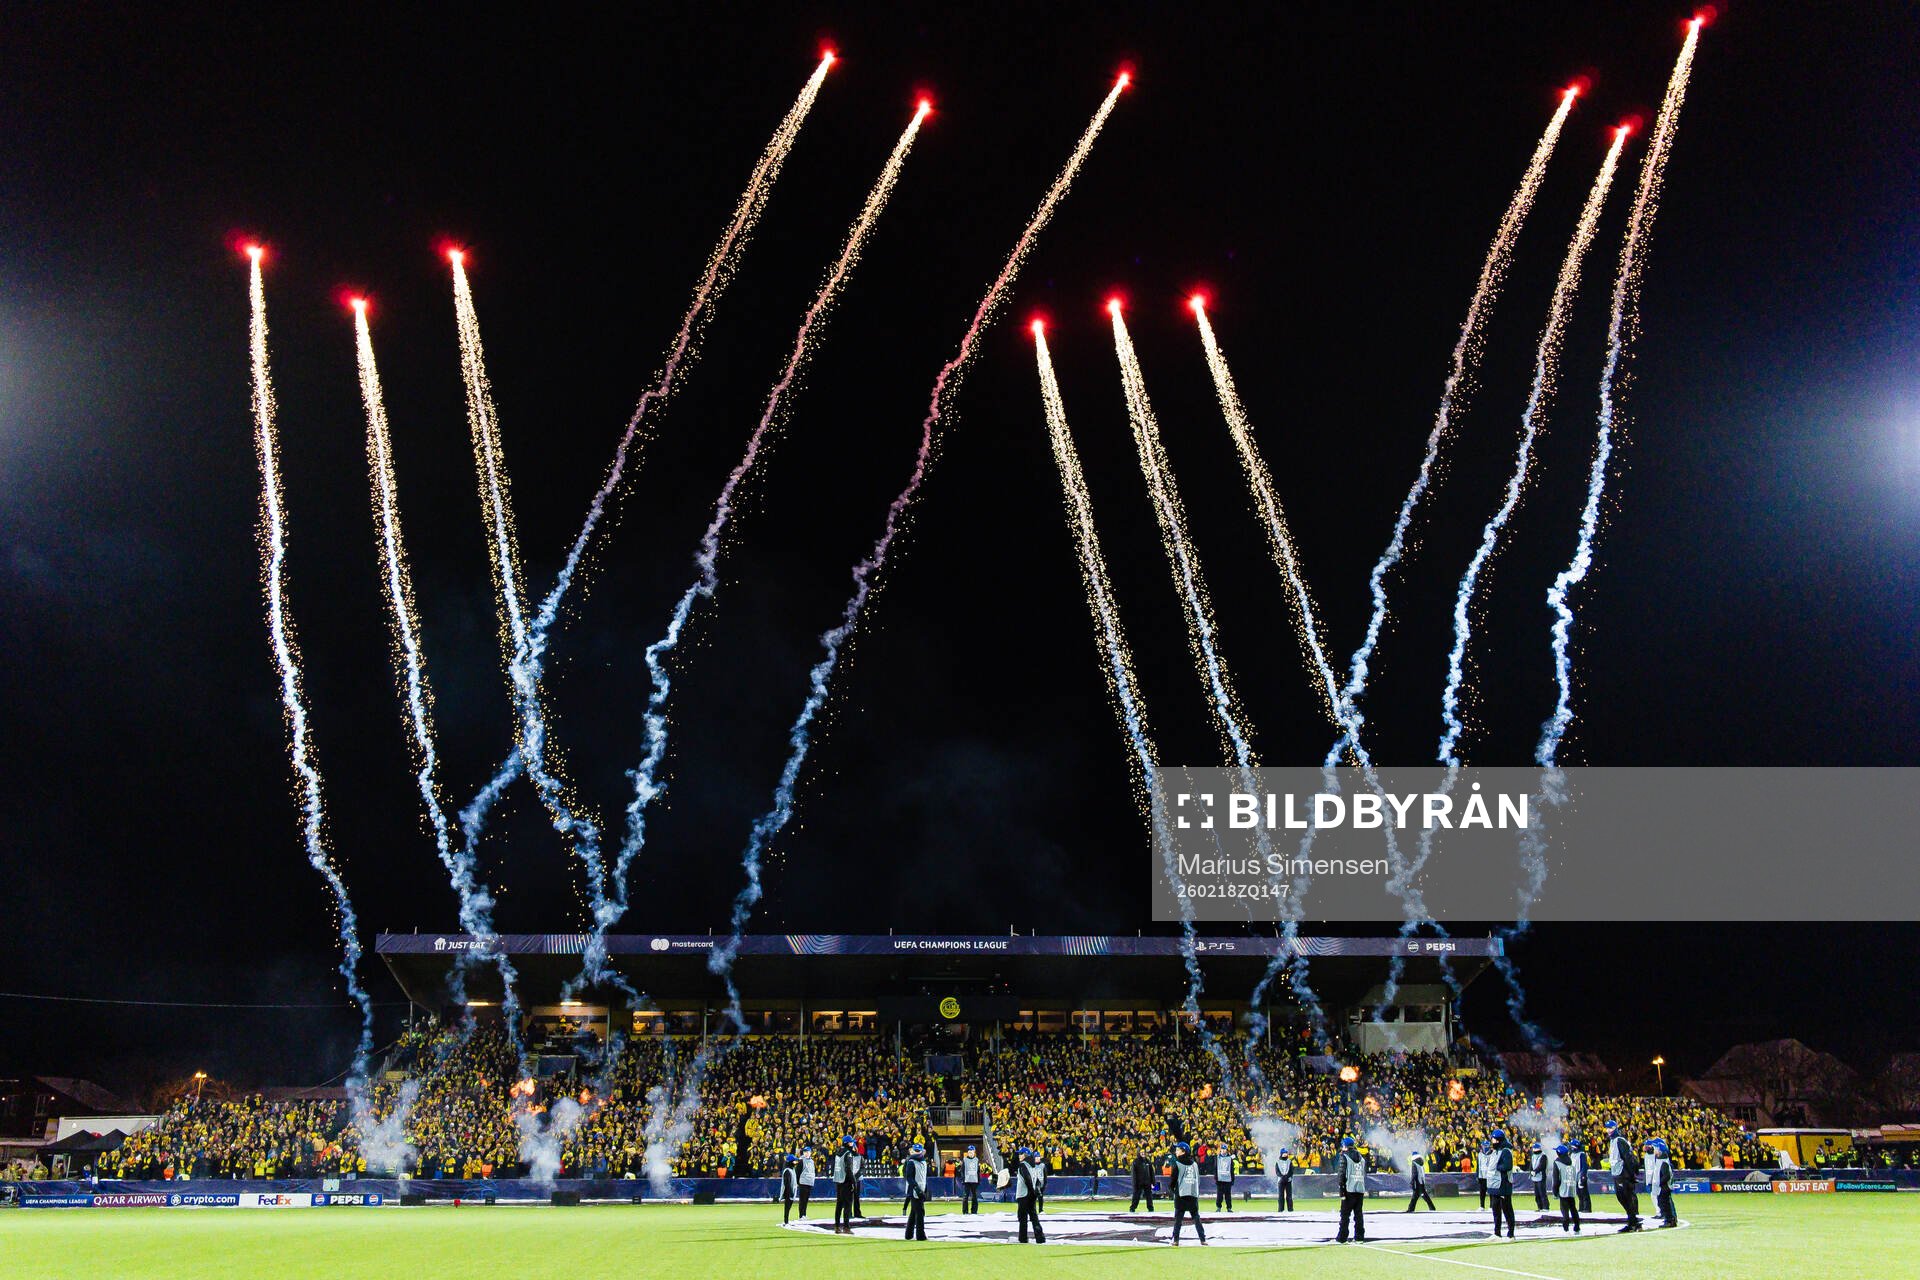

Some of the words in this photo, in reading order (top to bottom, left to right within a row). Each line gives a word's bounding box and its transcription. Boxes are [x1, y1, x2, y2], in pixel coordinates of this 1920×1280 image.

[447, 941, 469, 950] JUST
[469, 941, 486, 949] EAT
[671, 940, 714, 948] mastercard
[894, 941, 917, 949] UEFA
[919, 941, 971, 949] CHAMPIONS
[973, 941, 1008, 949] LEAGUE
[1208, 942, 1236, 950] PS5
[1426, 943, 1456, 951] PEPSI
[1673, 1183, 1699, 1192] PS5
[1723, 1181, 1772, 1192] mastercard
[1790, 1182, 1811, 1192] JUST
[1812, 1182, 1829, 1191] EAT
[93, 1196, 126, 1206] QATAR
[127, 1195, 167, 1204] AIRWAYS
[183, 1195, 236, 1205] crypto.com
[258, 1195, 291, 1205] FedEx
[330, 1195, 364, 1205] PEPSI
